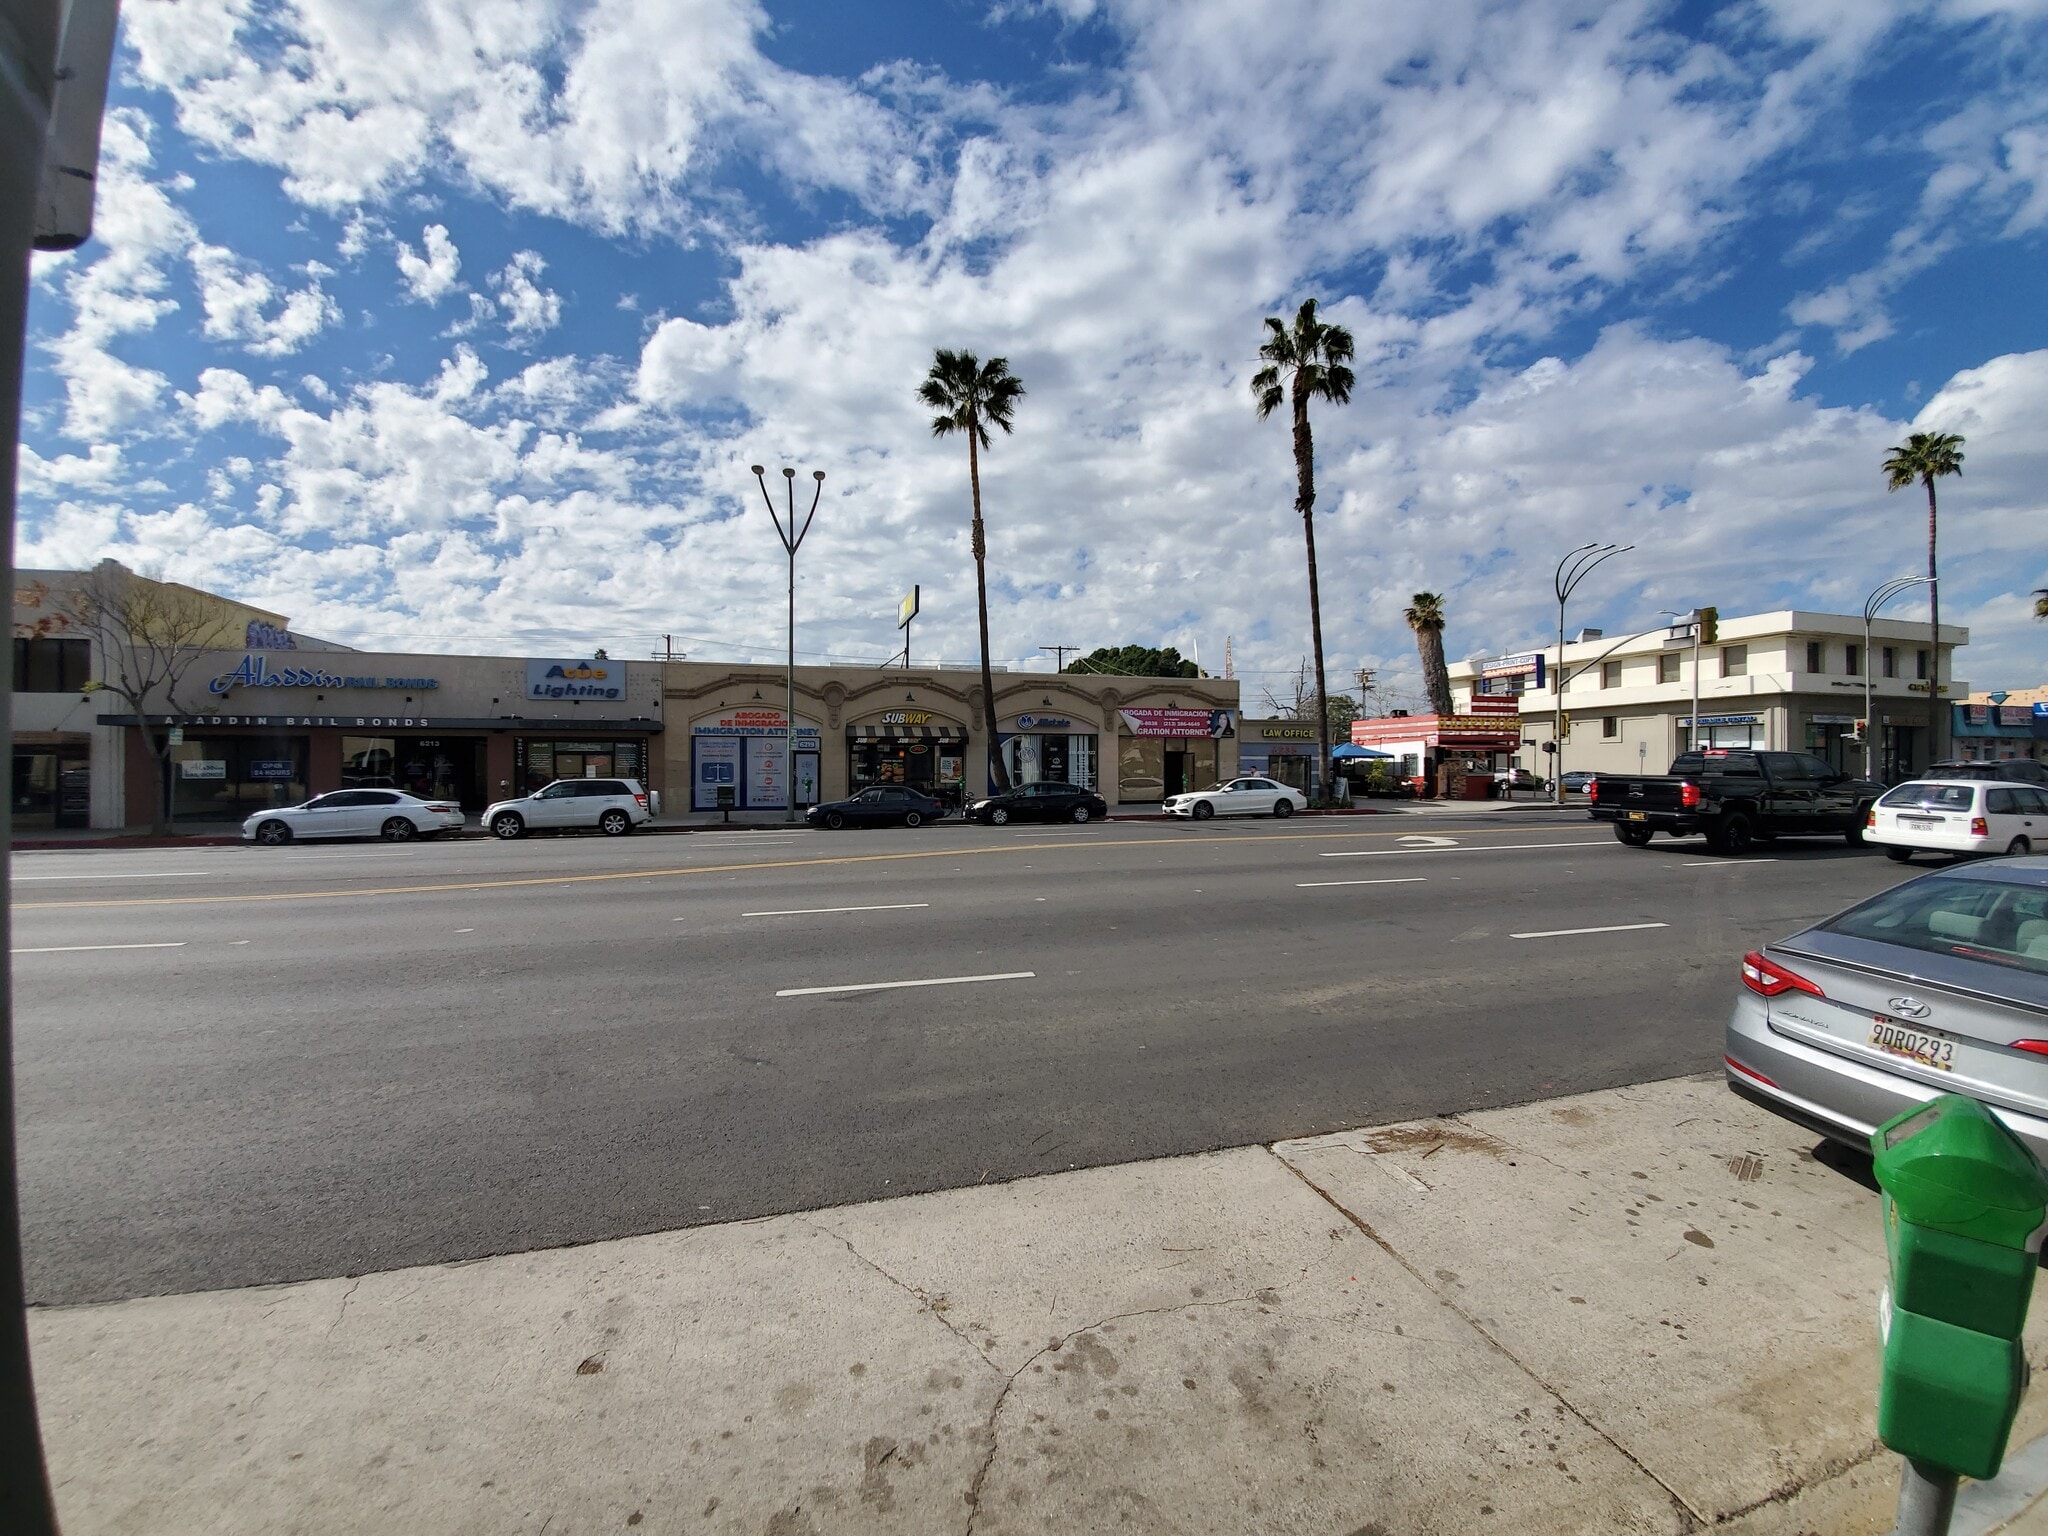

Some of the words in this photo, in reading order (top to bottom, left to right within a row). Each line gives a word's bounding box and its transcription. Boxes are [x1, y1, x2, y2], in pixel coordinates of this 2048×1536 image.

[208, 654, 345, 694] Aladdin
[385, 677, 439, 690] BONDS
[533, 684, 619, 698] Lighting
[286, 717, 338, 726] BAIL
[357, 718, 429, 727] BONDS
[882, 712, 932, 724] SUBWAY
[694, 727, 764, 735] IMMIGRATION
[1172, 728, 1208, 736] ATTORNEY
[1263, 729, 1282, 737] LAW
[1284, 730, 1315, 738] OFFICE
